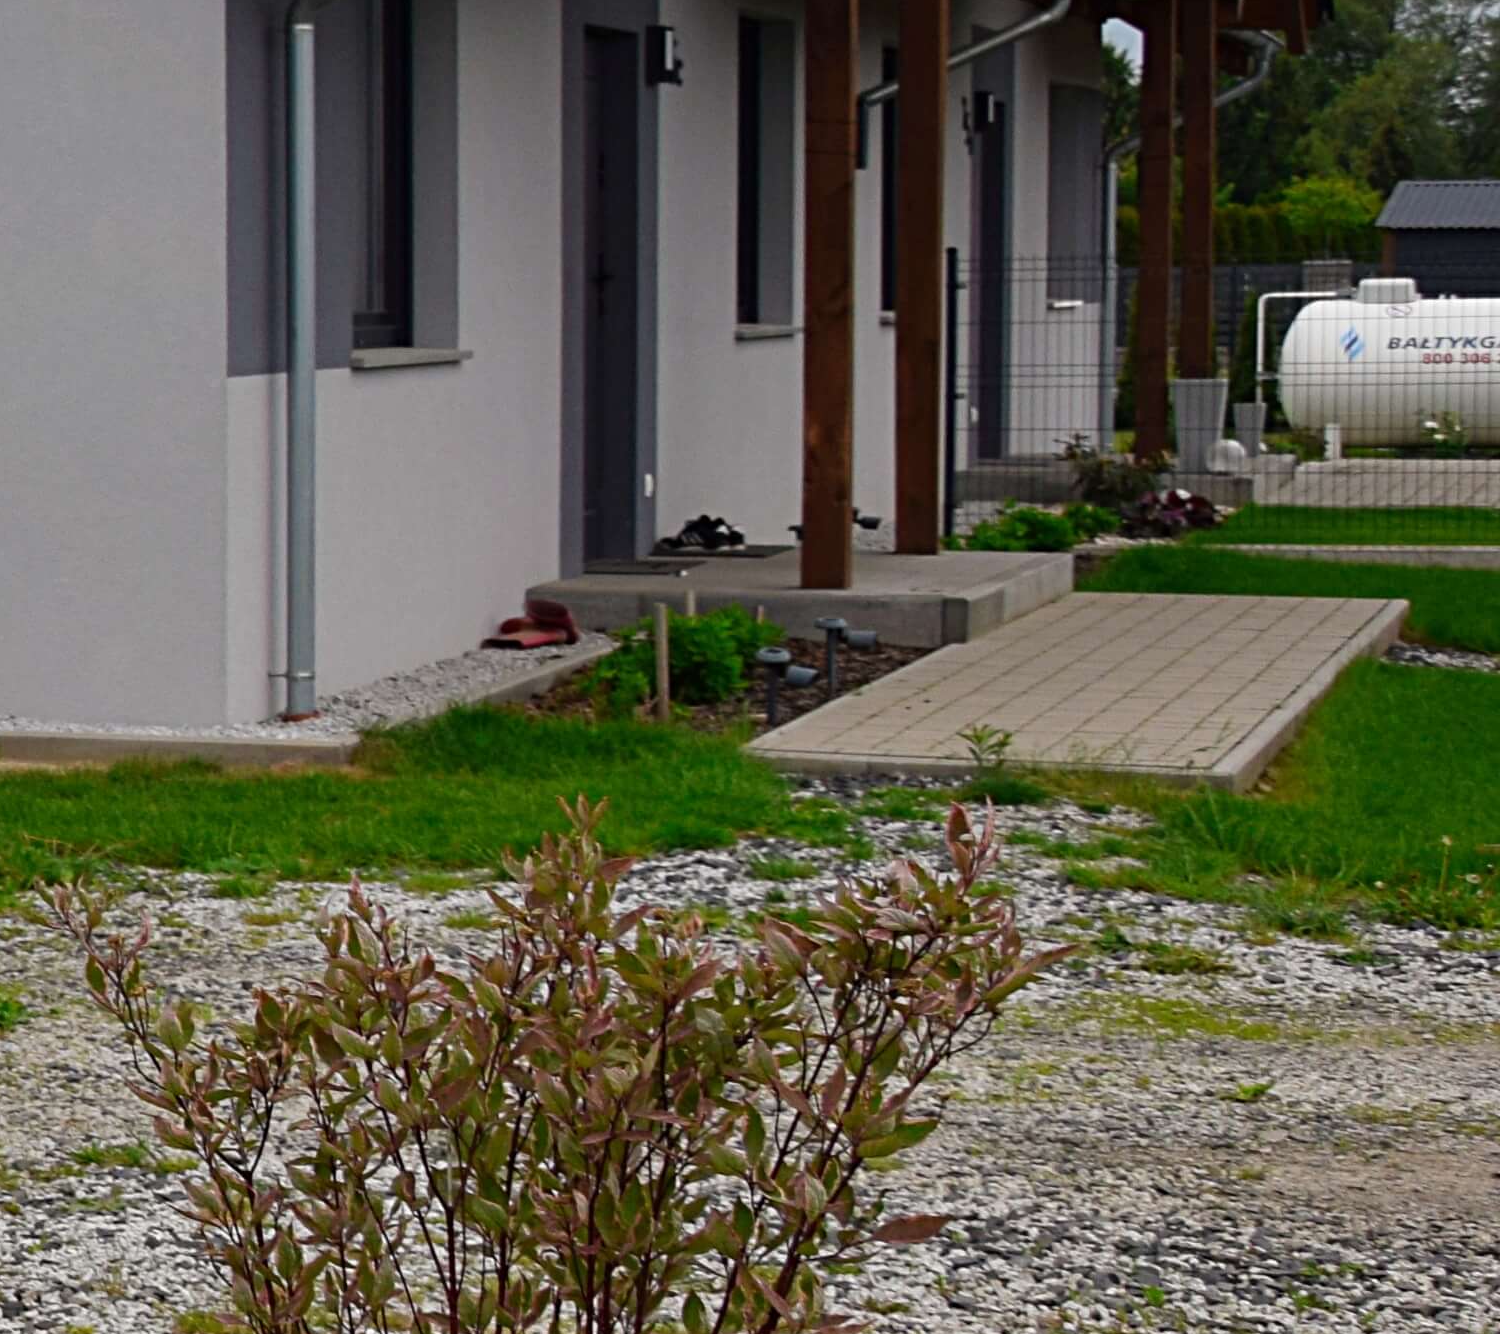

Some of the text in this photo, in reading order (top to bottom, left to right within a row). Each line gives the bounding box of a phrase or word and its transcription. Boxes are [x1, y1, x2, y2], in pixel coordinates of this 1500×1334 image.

[1387, 336, 1500, 349] BAŁTYKG
[1423, 353, 1453, 364] 800
[1461, 353, 1492, 364] 306
